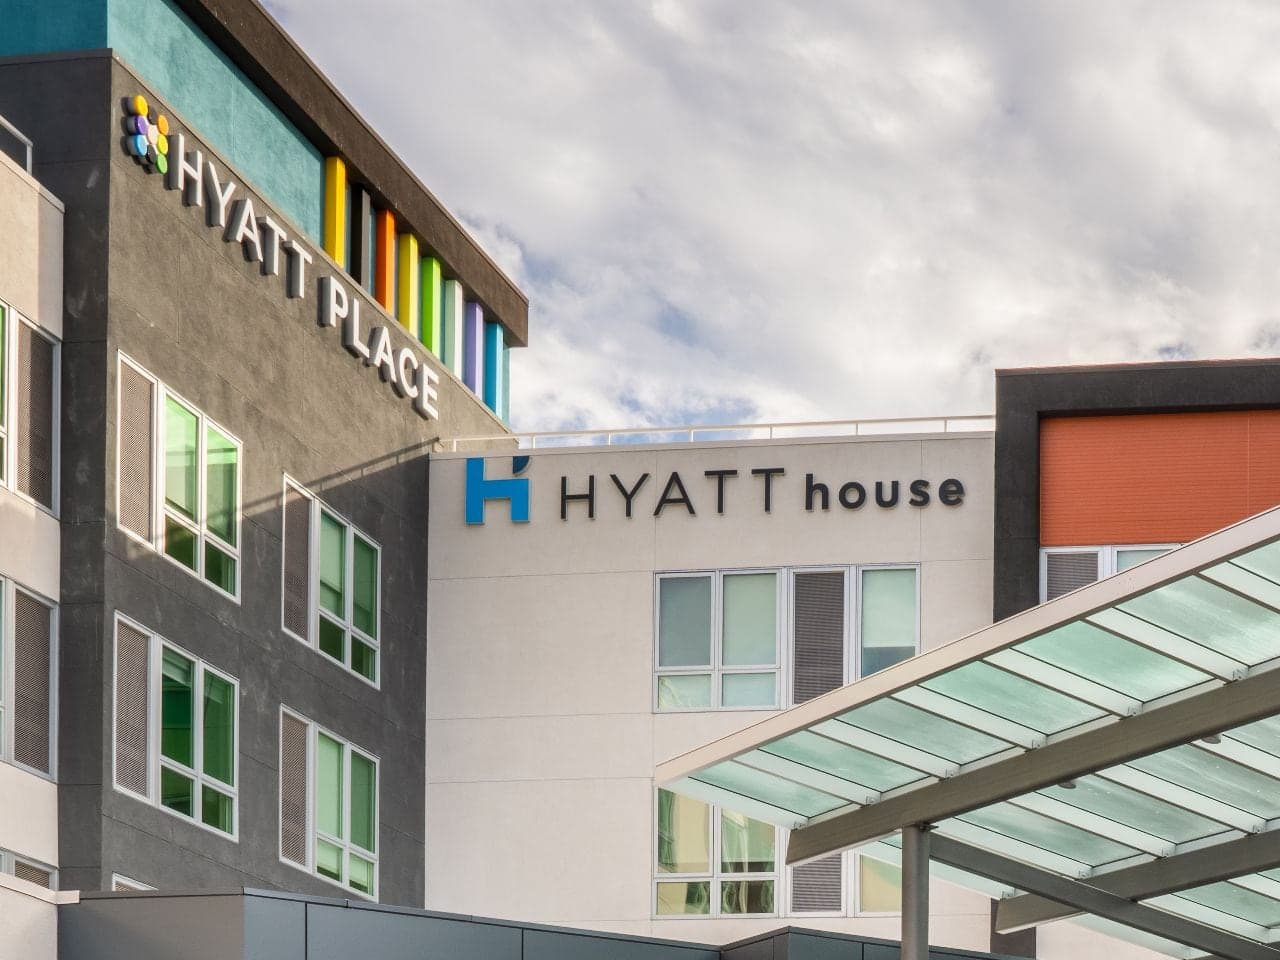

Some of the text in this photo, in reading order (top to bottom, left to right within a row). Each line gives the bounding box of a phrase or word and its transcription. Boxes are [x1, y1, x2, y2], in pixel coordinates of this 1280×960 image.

[168, 133, 440, 421] HYATT PLACE
[559, 467, 786, 521] HYATT
[803, 472, 967, 512] house
